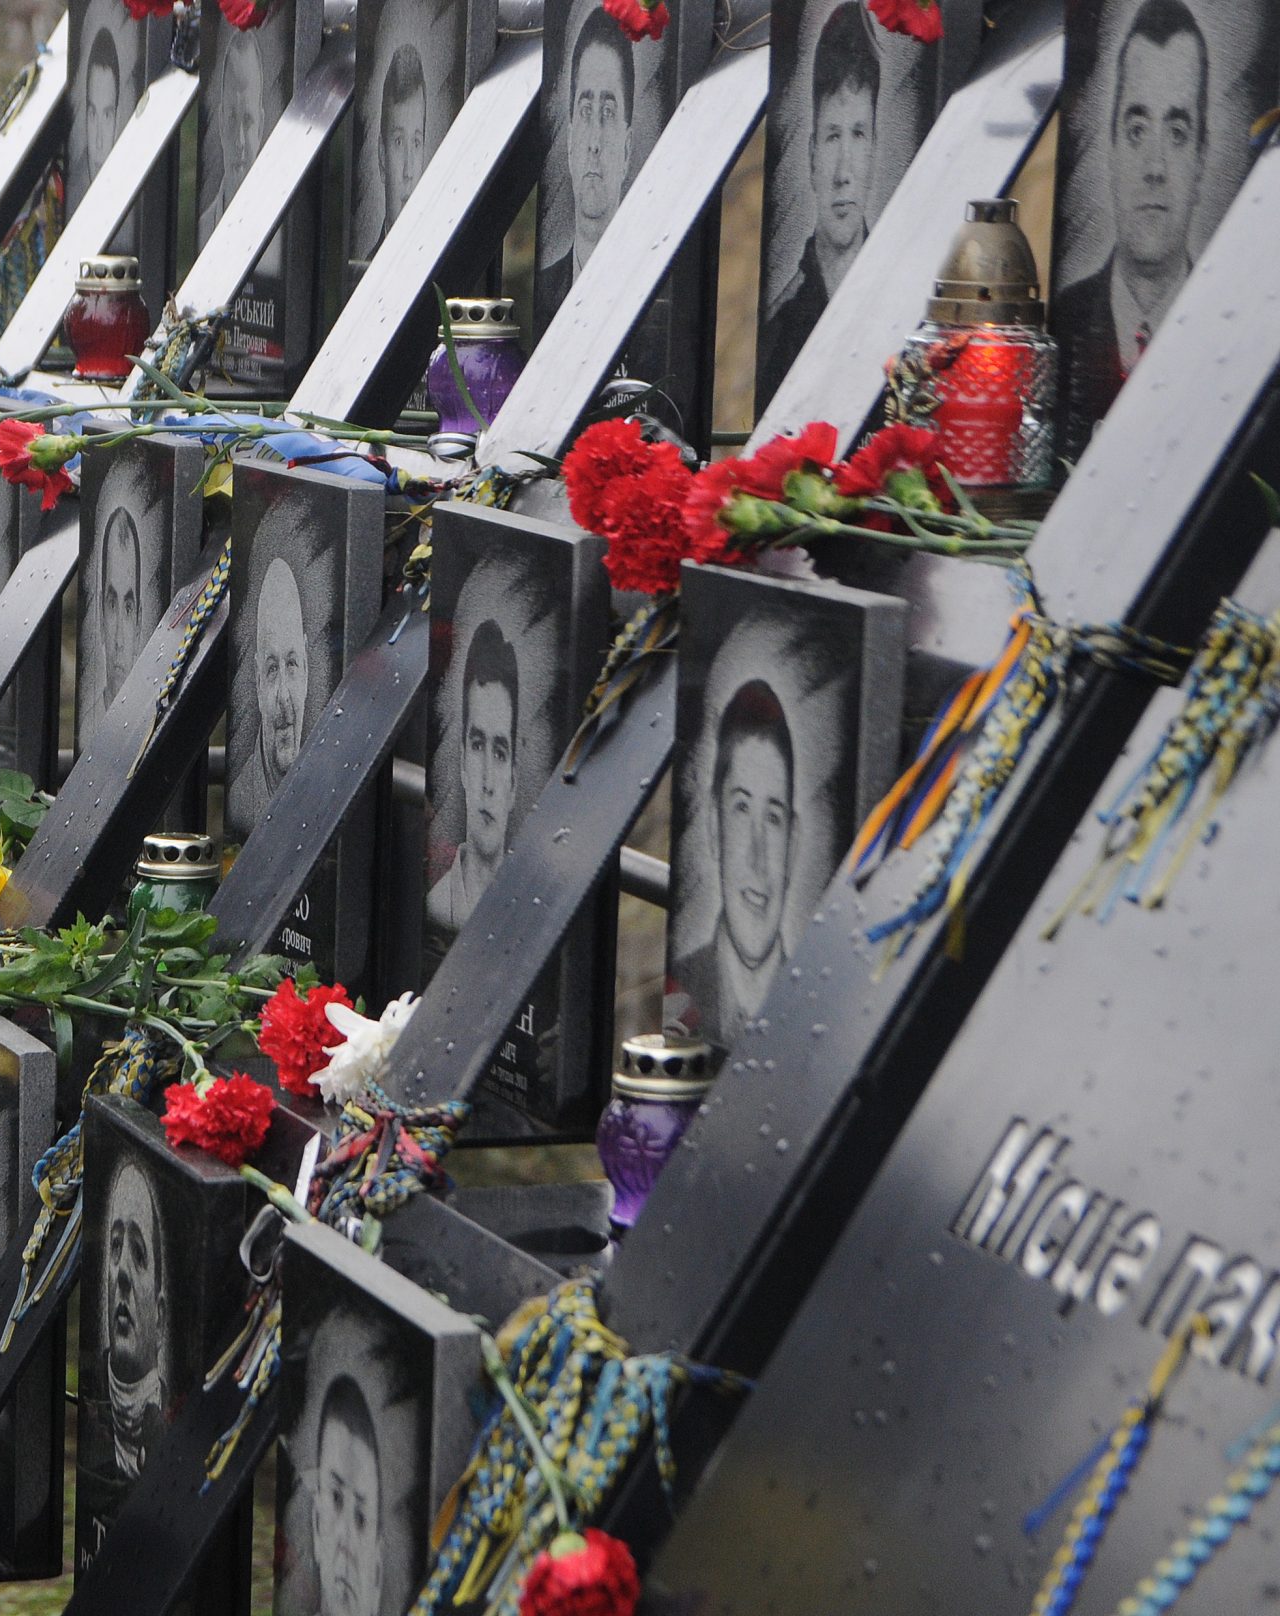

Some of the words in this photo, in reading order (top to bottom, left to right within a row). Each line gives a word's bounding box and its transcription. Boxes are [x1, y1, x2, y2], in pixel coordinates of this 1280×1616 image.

[231, 298, 275, 328] РСЬКИЙ
[233, 325, 267, 354] Петрович
[947, 1113, 1161, 1319] Місце
